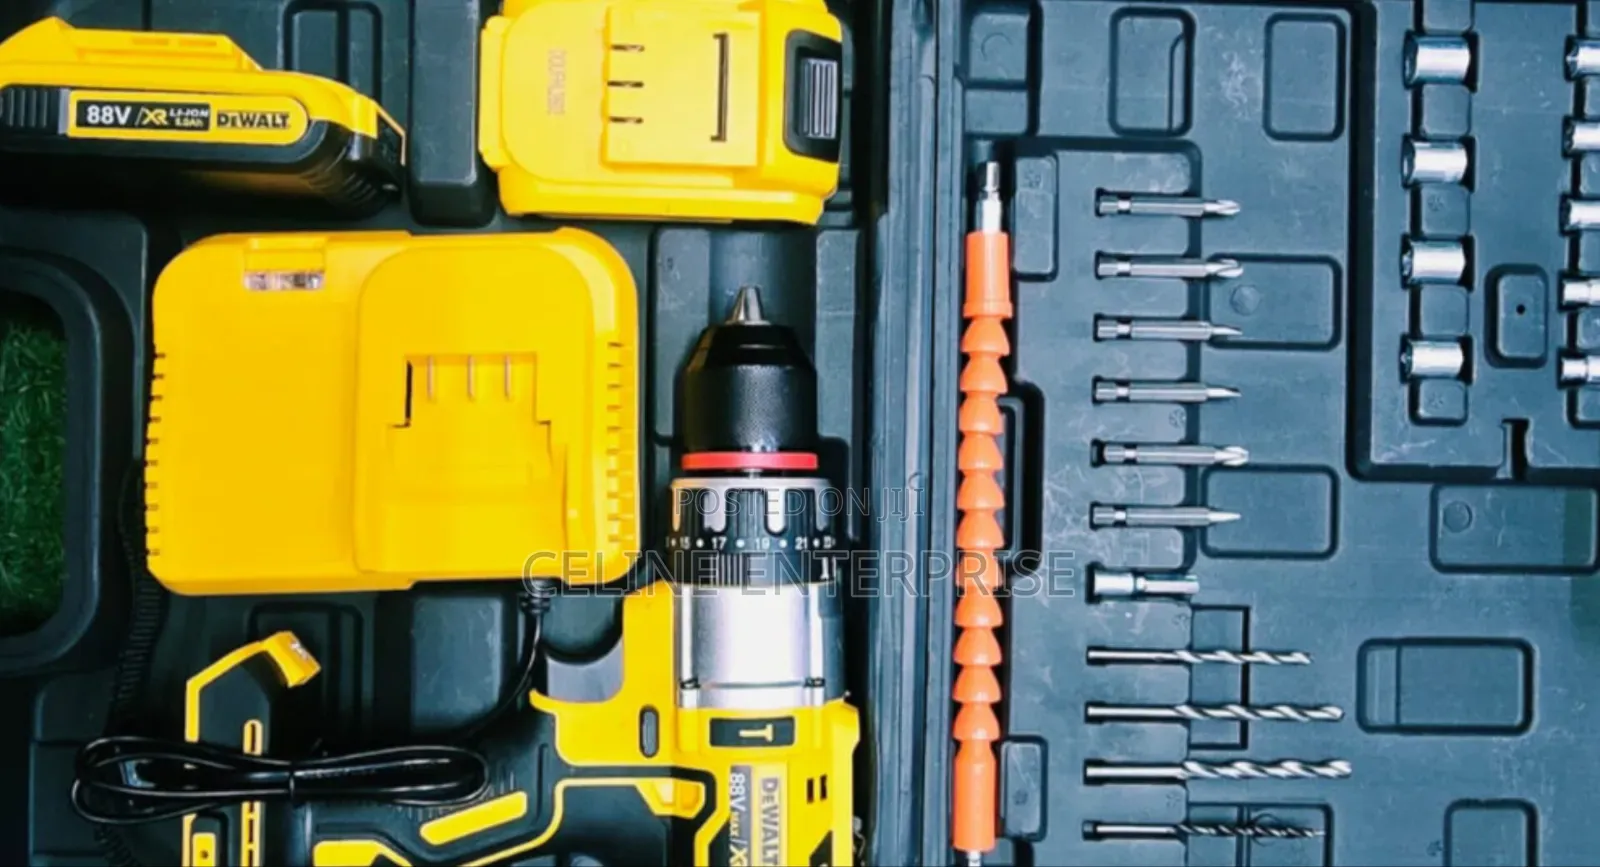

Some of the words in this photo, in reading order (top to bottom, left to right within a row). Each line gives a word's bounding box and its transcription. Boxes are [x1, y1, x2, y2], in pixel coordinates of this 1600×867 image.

[86, 104, 132, 125] 88V
[711, 536, 728, 550] 17
[755, 536, 771, 550] 19
[795, 536, 809, 550] 21
[730, 772, 746, 812] 88V
[729, 843, 749, 867] X
